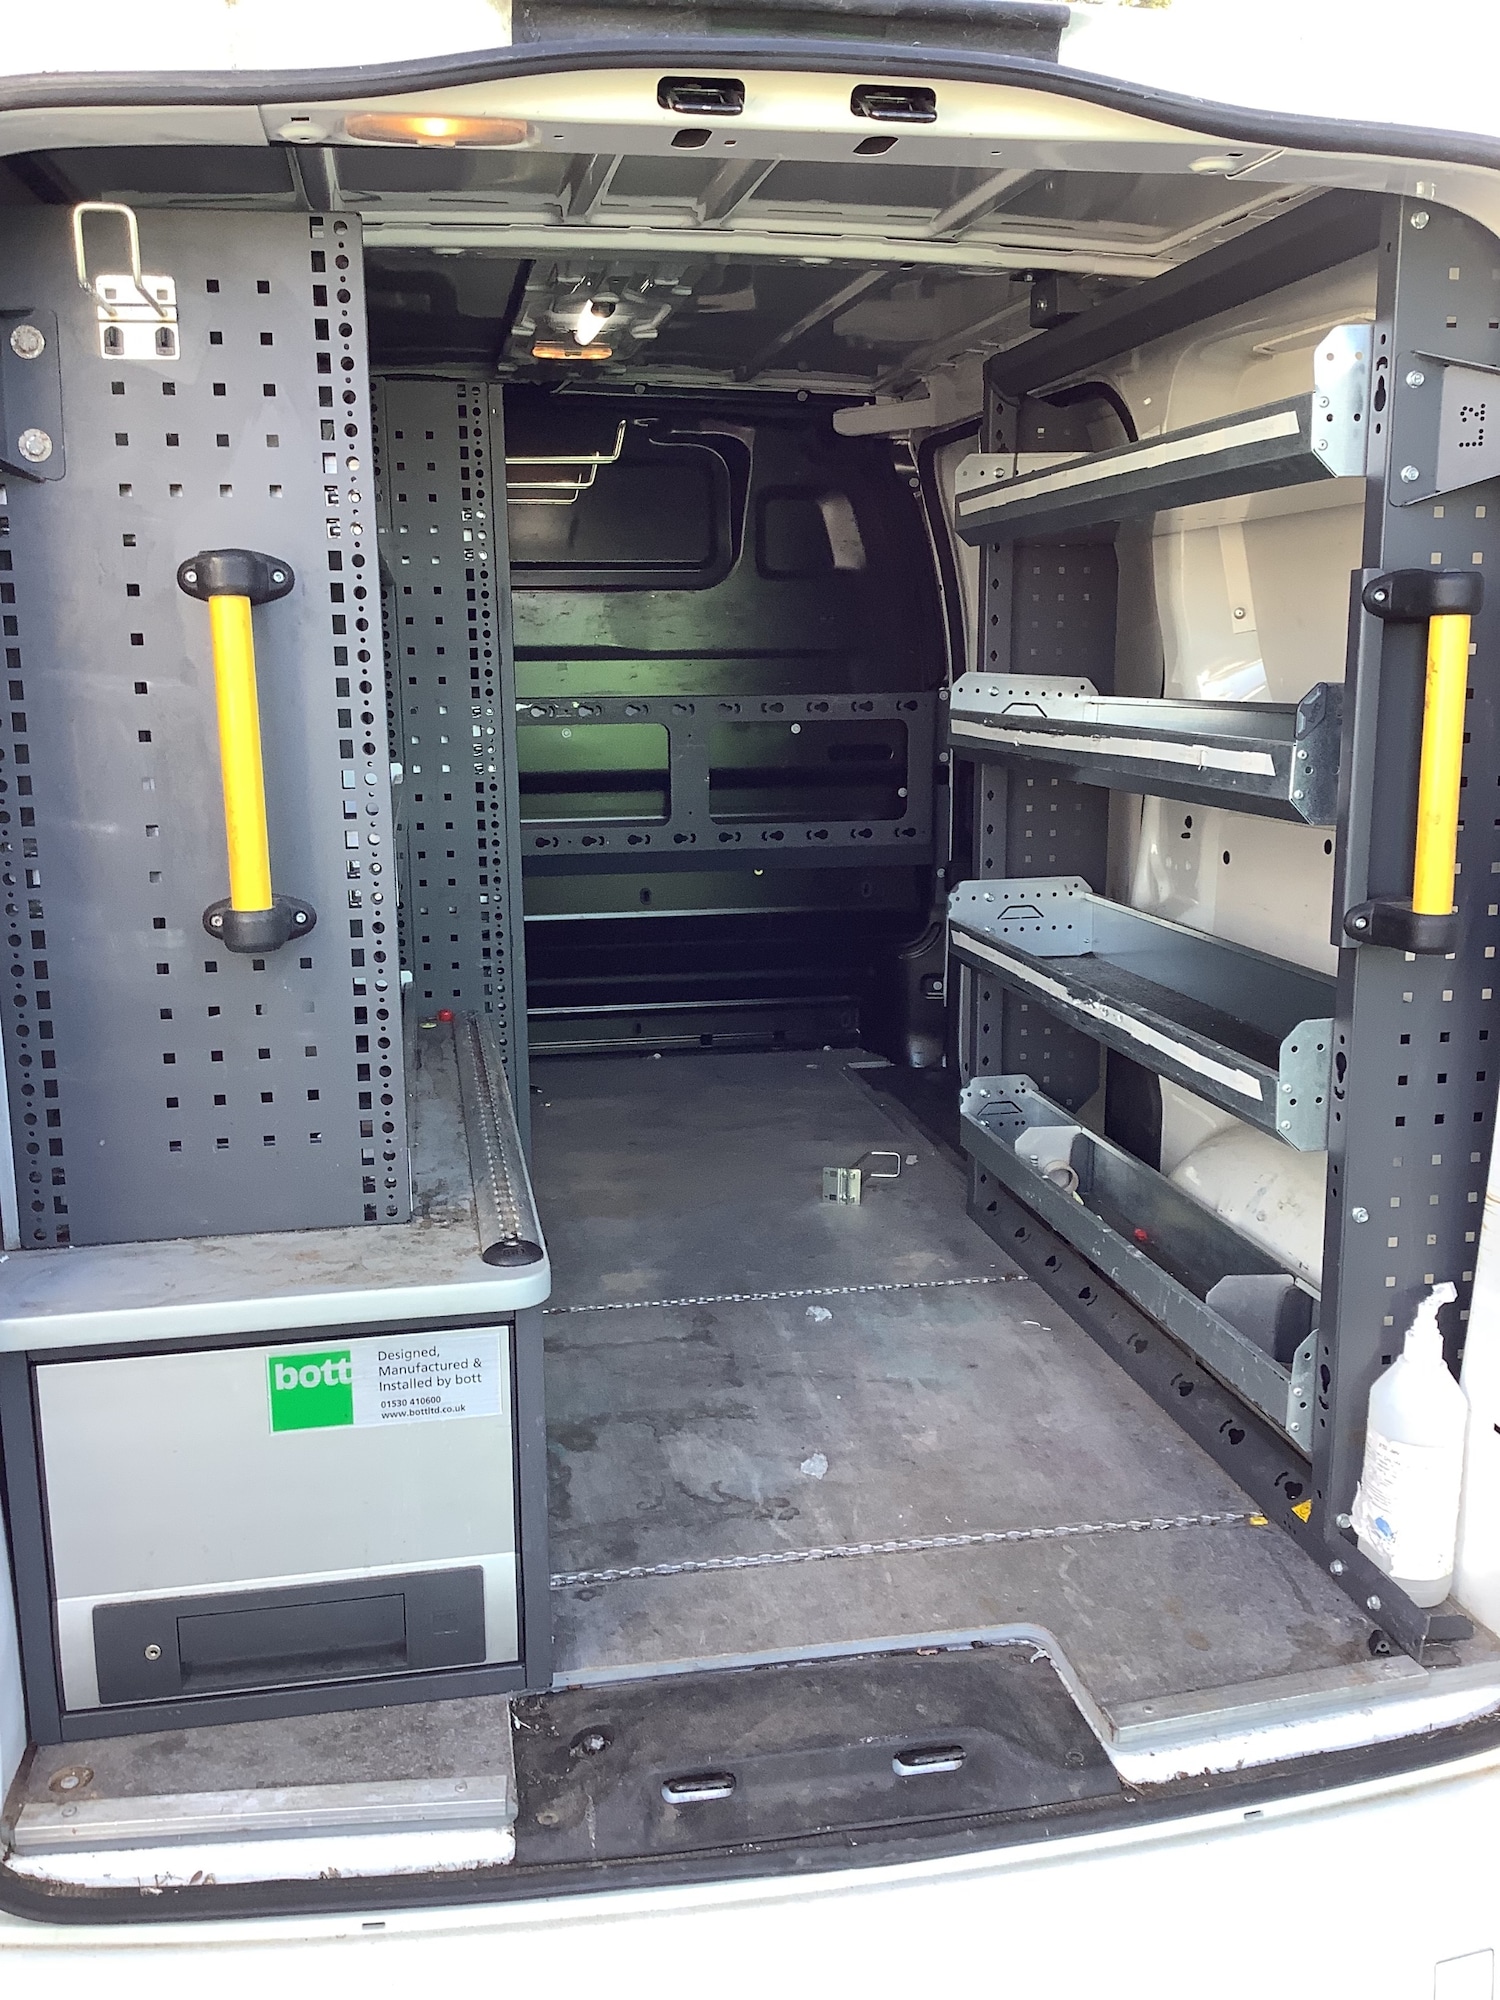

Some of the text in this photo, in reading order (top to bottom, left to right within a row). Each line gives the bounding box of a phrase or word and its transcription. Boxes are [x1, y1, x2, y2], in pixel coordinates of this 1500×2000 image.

[378, 1346, 440, 1361] Designed,
[275, 1358, 353, 1391] bott
[379, 1357, 482, 1377] Manufactured &
[379, 1373, 482, 1392] Installed by bott
[380, 1395, 442, 1409] 01530 410600
[381, 1404, 466, 1419] www.bottltd.co.uk
